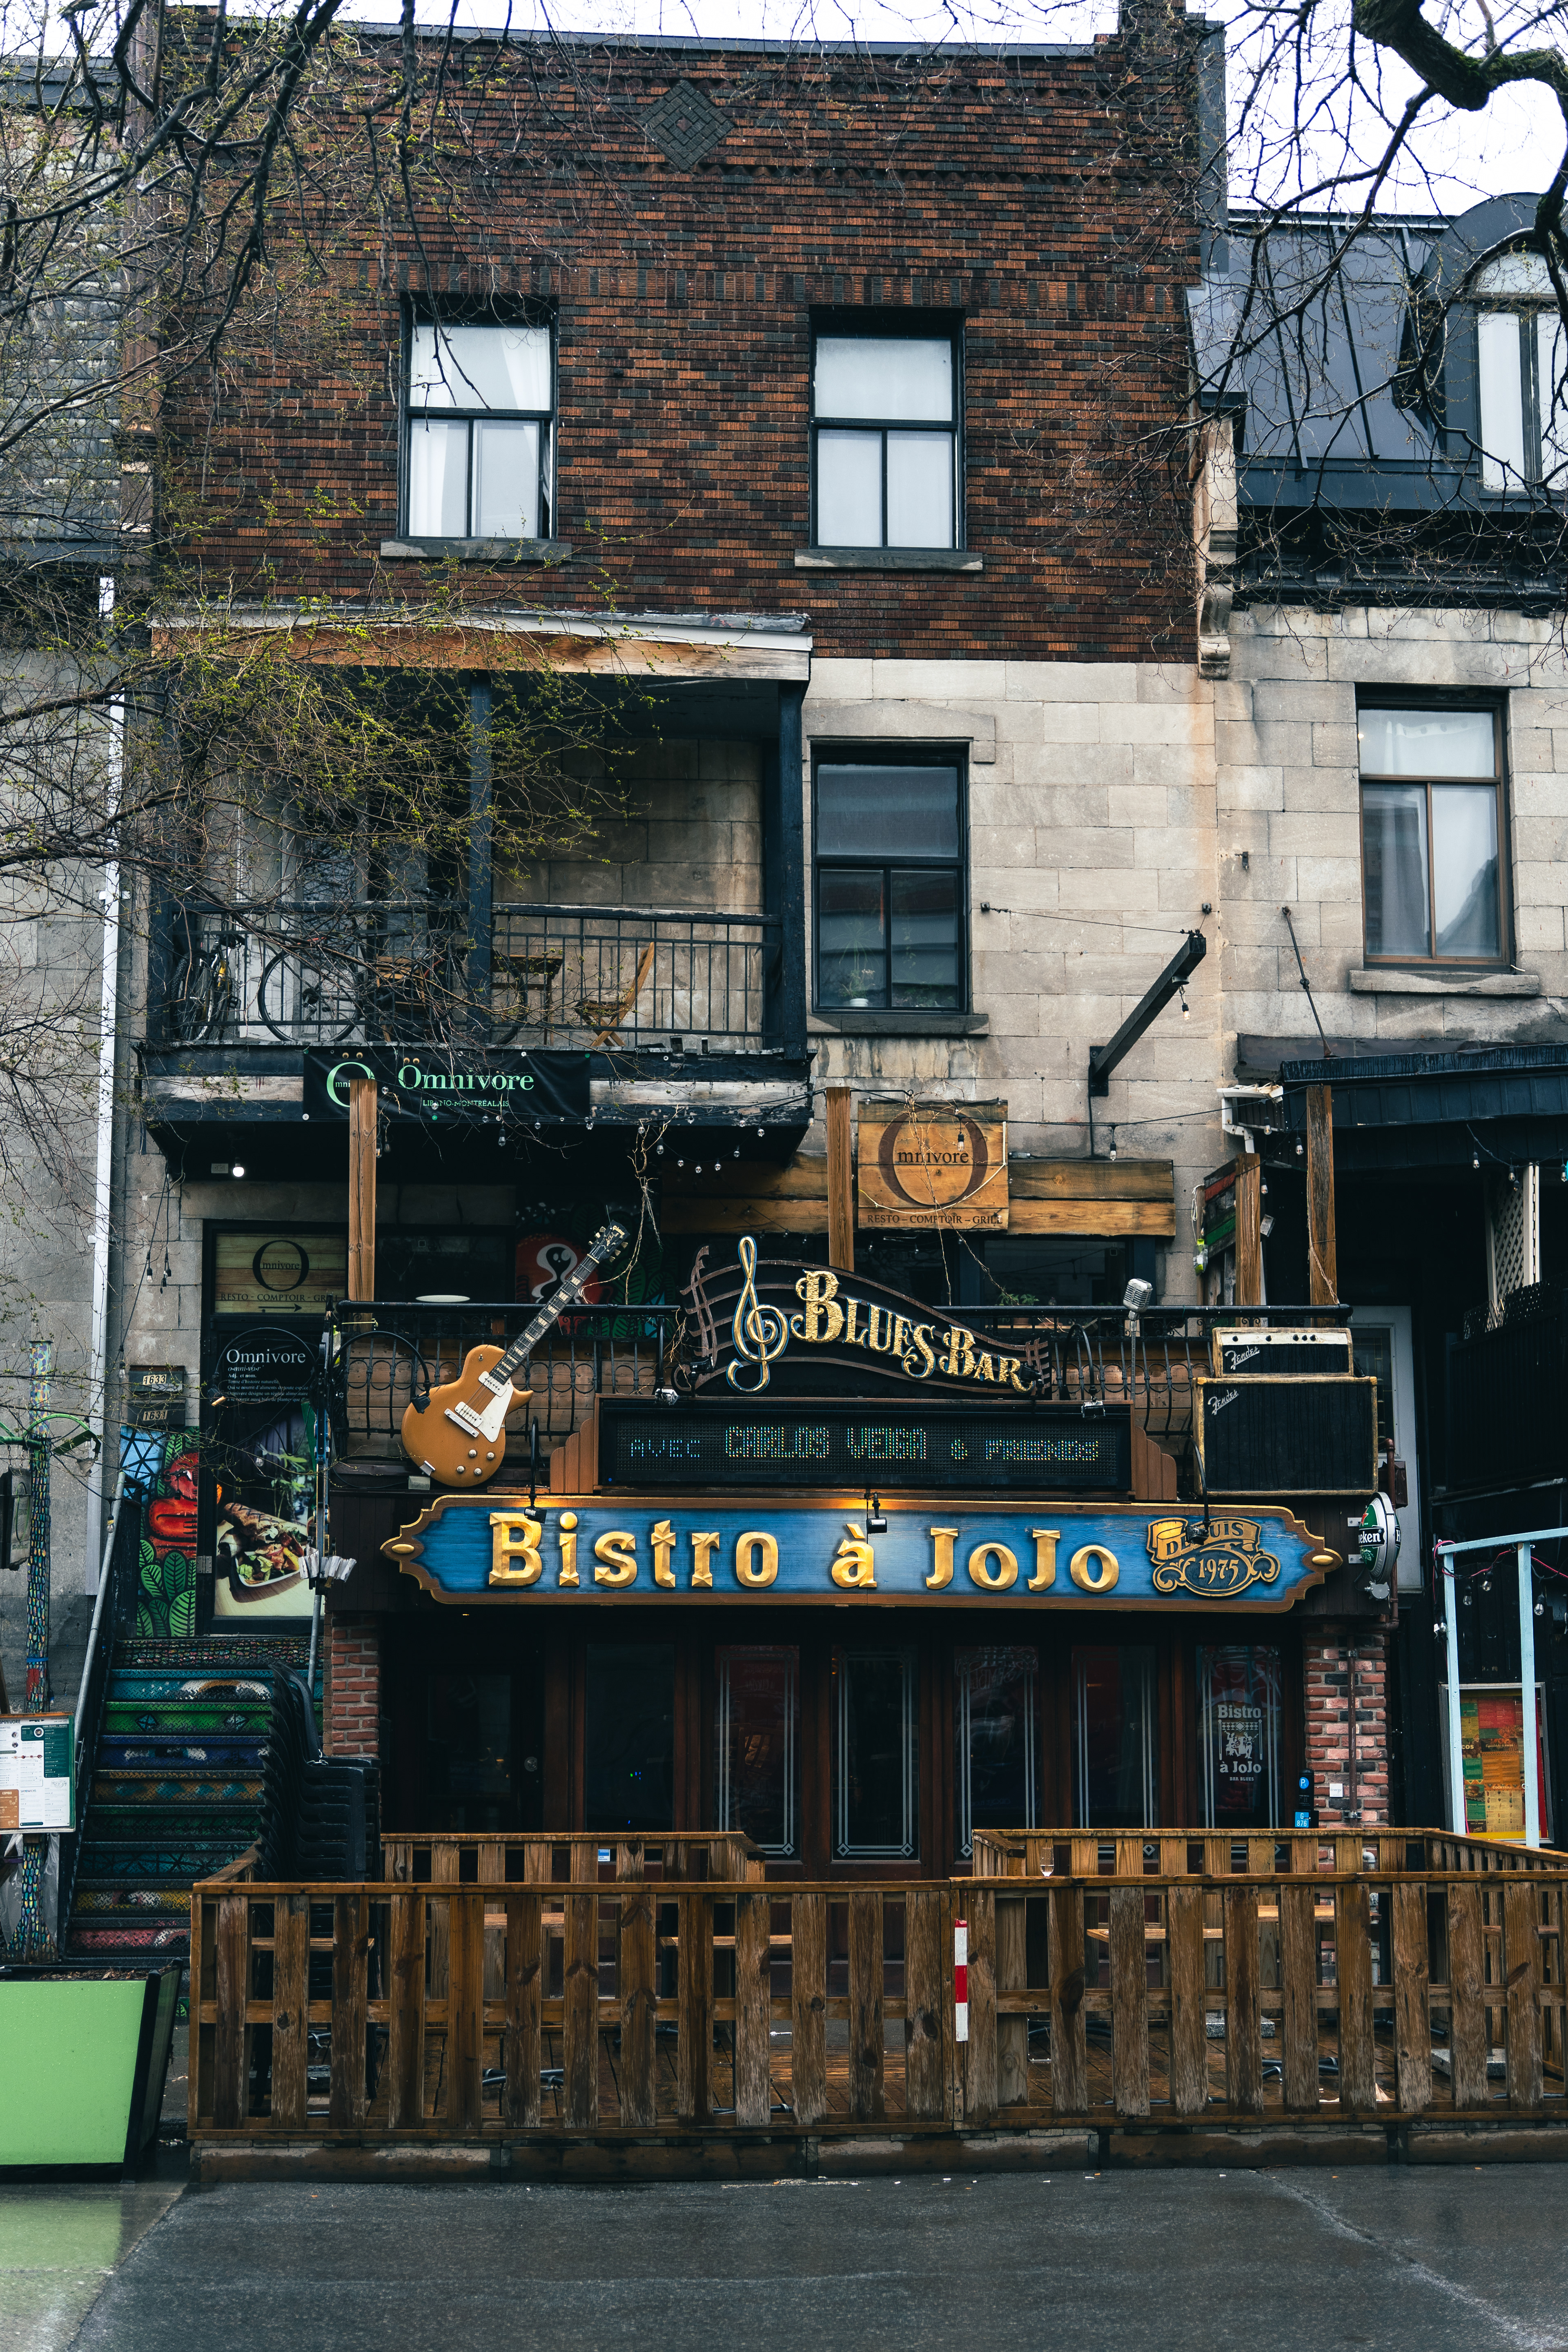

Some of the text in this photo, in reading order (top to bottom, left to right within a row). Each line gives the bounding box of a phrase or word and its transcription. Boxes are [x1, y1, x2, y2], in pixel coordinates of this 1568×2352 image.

[398, 1065, 534, 1090] Omnivore
[867, 1215, 900, 1223] RESTO
[910, 1215, 963, 1224] COMPTOIR
[227, 1349, 305, 1363] Omnivore
[1225, 1346, 1260, 1370] Fender
[144, 1375, 166, 1385] 1633
[1208, 1389, 1238, 1415] Fender
[631, 1439, 700, 1457] AVEC
[726, 1426, 829, 1458] CARLOS
[985, 1439, 1098, 1461] FRIENDS
[489, 1511, 1119, 1593] Bistro à JoJo
[1218, 1704, 1261, 1719] Bistro
[1220, 1761, 1262, 1773] à JoJo
